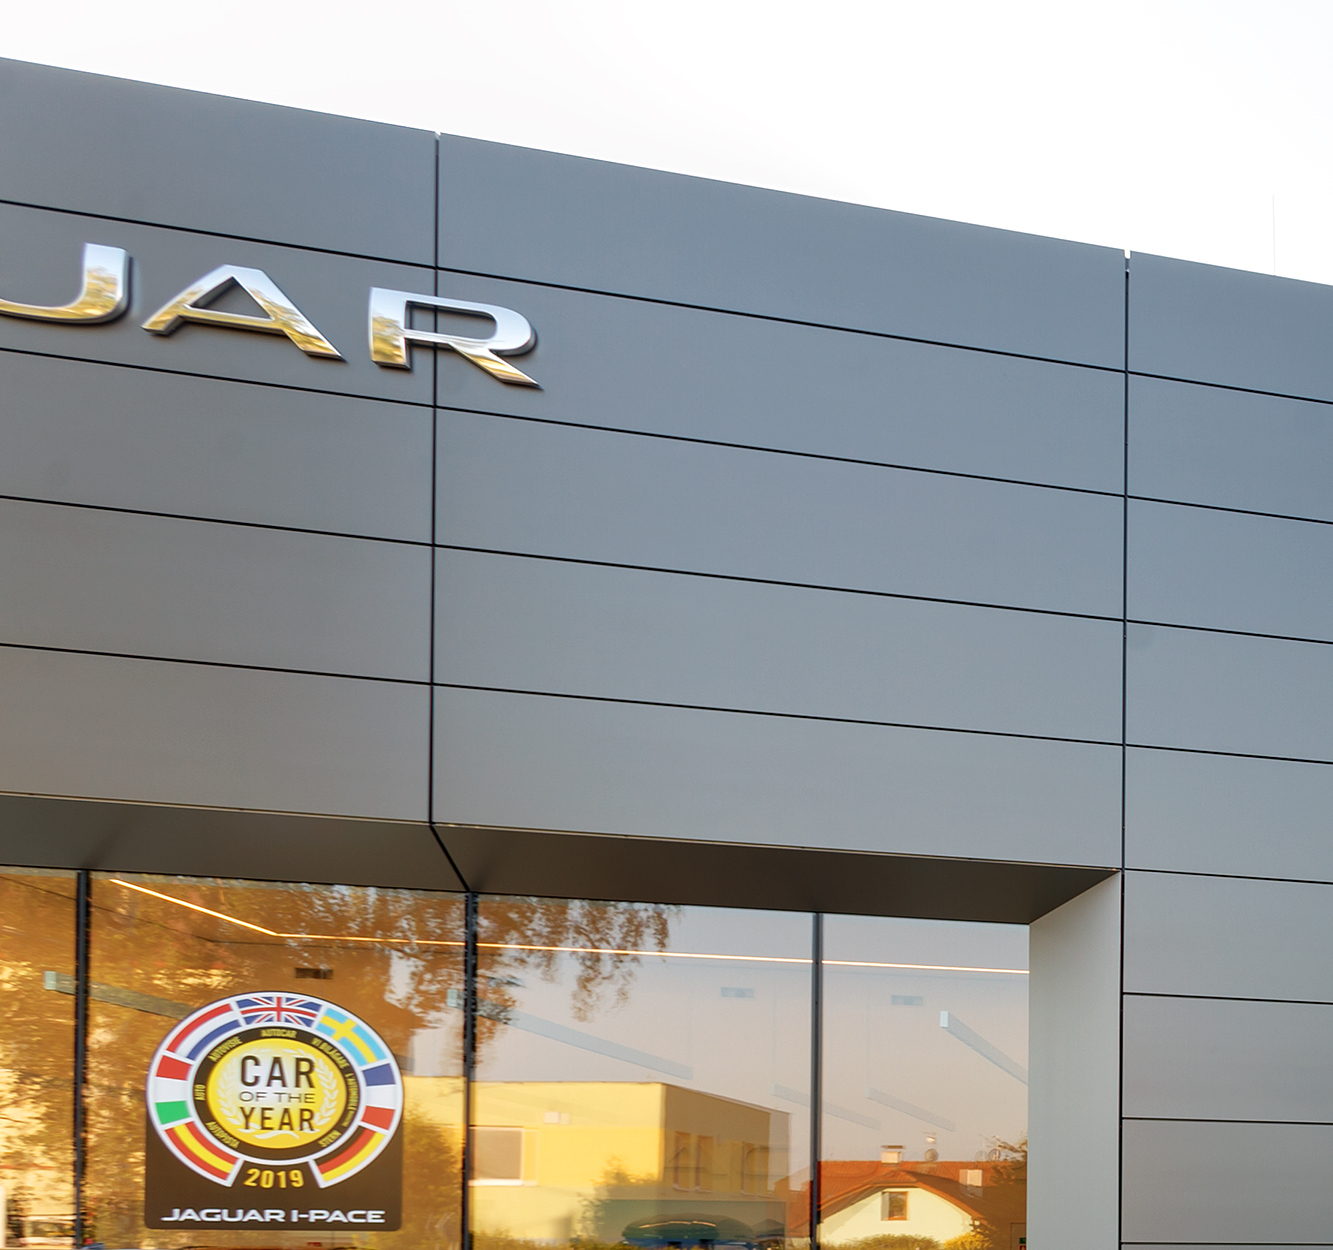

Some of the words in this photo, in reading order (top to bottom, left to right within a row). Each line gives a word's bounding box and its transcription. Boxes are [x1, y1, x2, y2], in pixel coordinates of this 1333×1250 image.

[241, 1055, 316, 1089] CAR
[195, 1084, 206, 1101] AUTO
[239, 1091, 268, 1103] OF
[274, 1091, 316, 1104] THE
[239, 1106, 316, 1131] YEAR
[243, 1168, 305, 1189] 2019
[161, 1208, 286, 1222] JAGUAR
[291, 1209, 386, 1223] I-PACE
